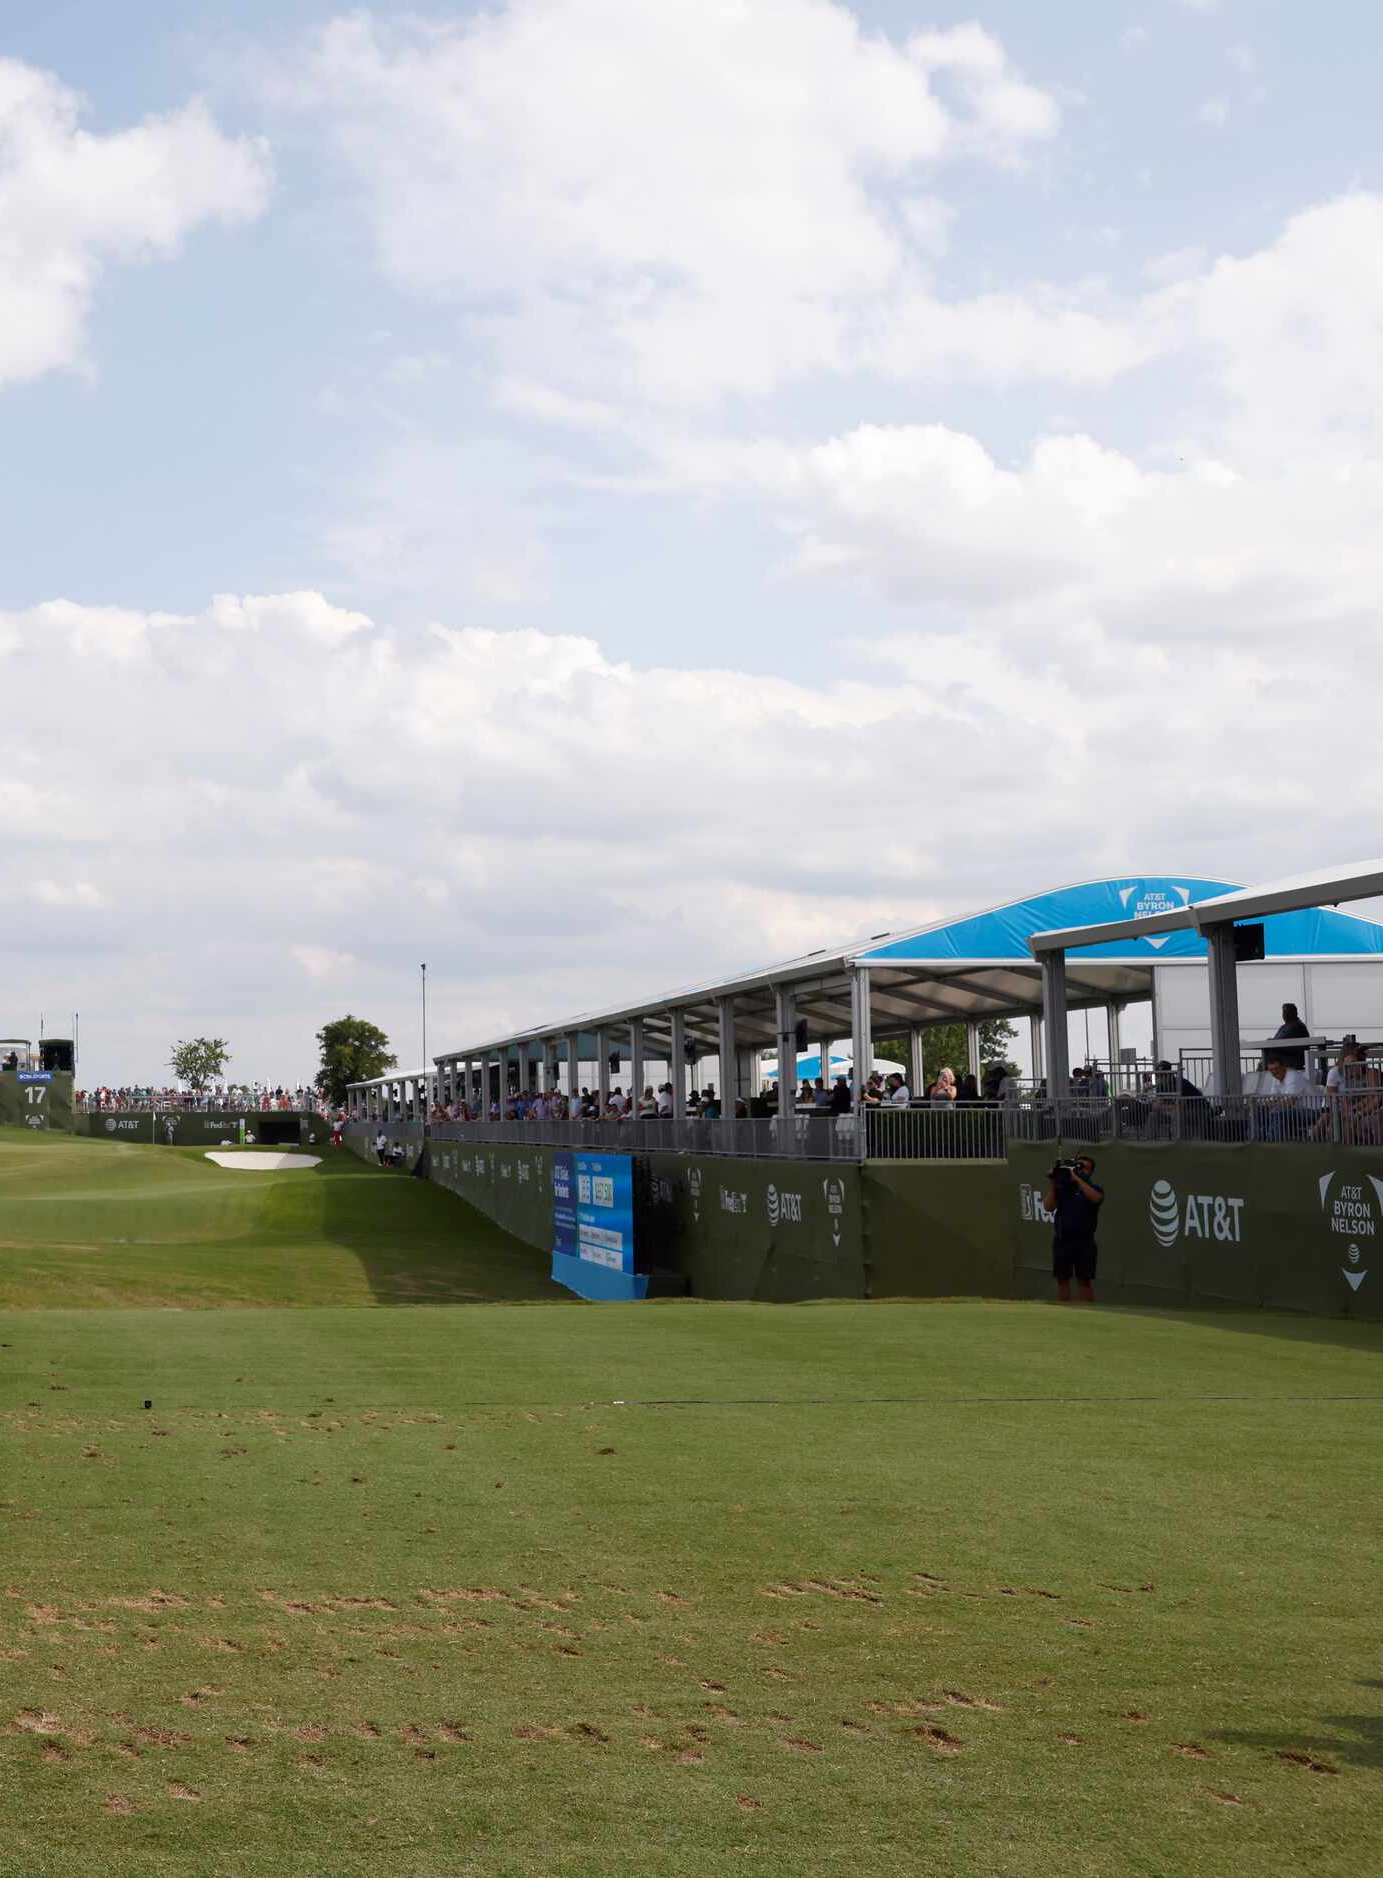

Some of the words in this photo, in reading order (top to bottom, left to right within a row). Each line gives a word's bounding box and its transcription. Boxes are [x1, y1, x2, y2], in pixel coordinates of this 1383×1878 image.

[1137, 902, 1175, 910] BYRON
[24, 1086, 47, 1104] 17
[117, 1121, 139, 1129] AT&T
[1340, 1185, 1362, 1200] AT&T
[780, 1192, 802, 1222] AT&T
[1333, 1200, 1371, 1218] BYRON
[1184, 1194, 1244, 1242] AT&T
[1330, 1219, 1376, 1236] NELSON
